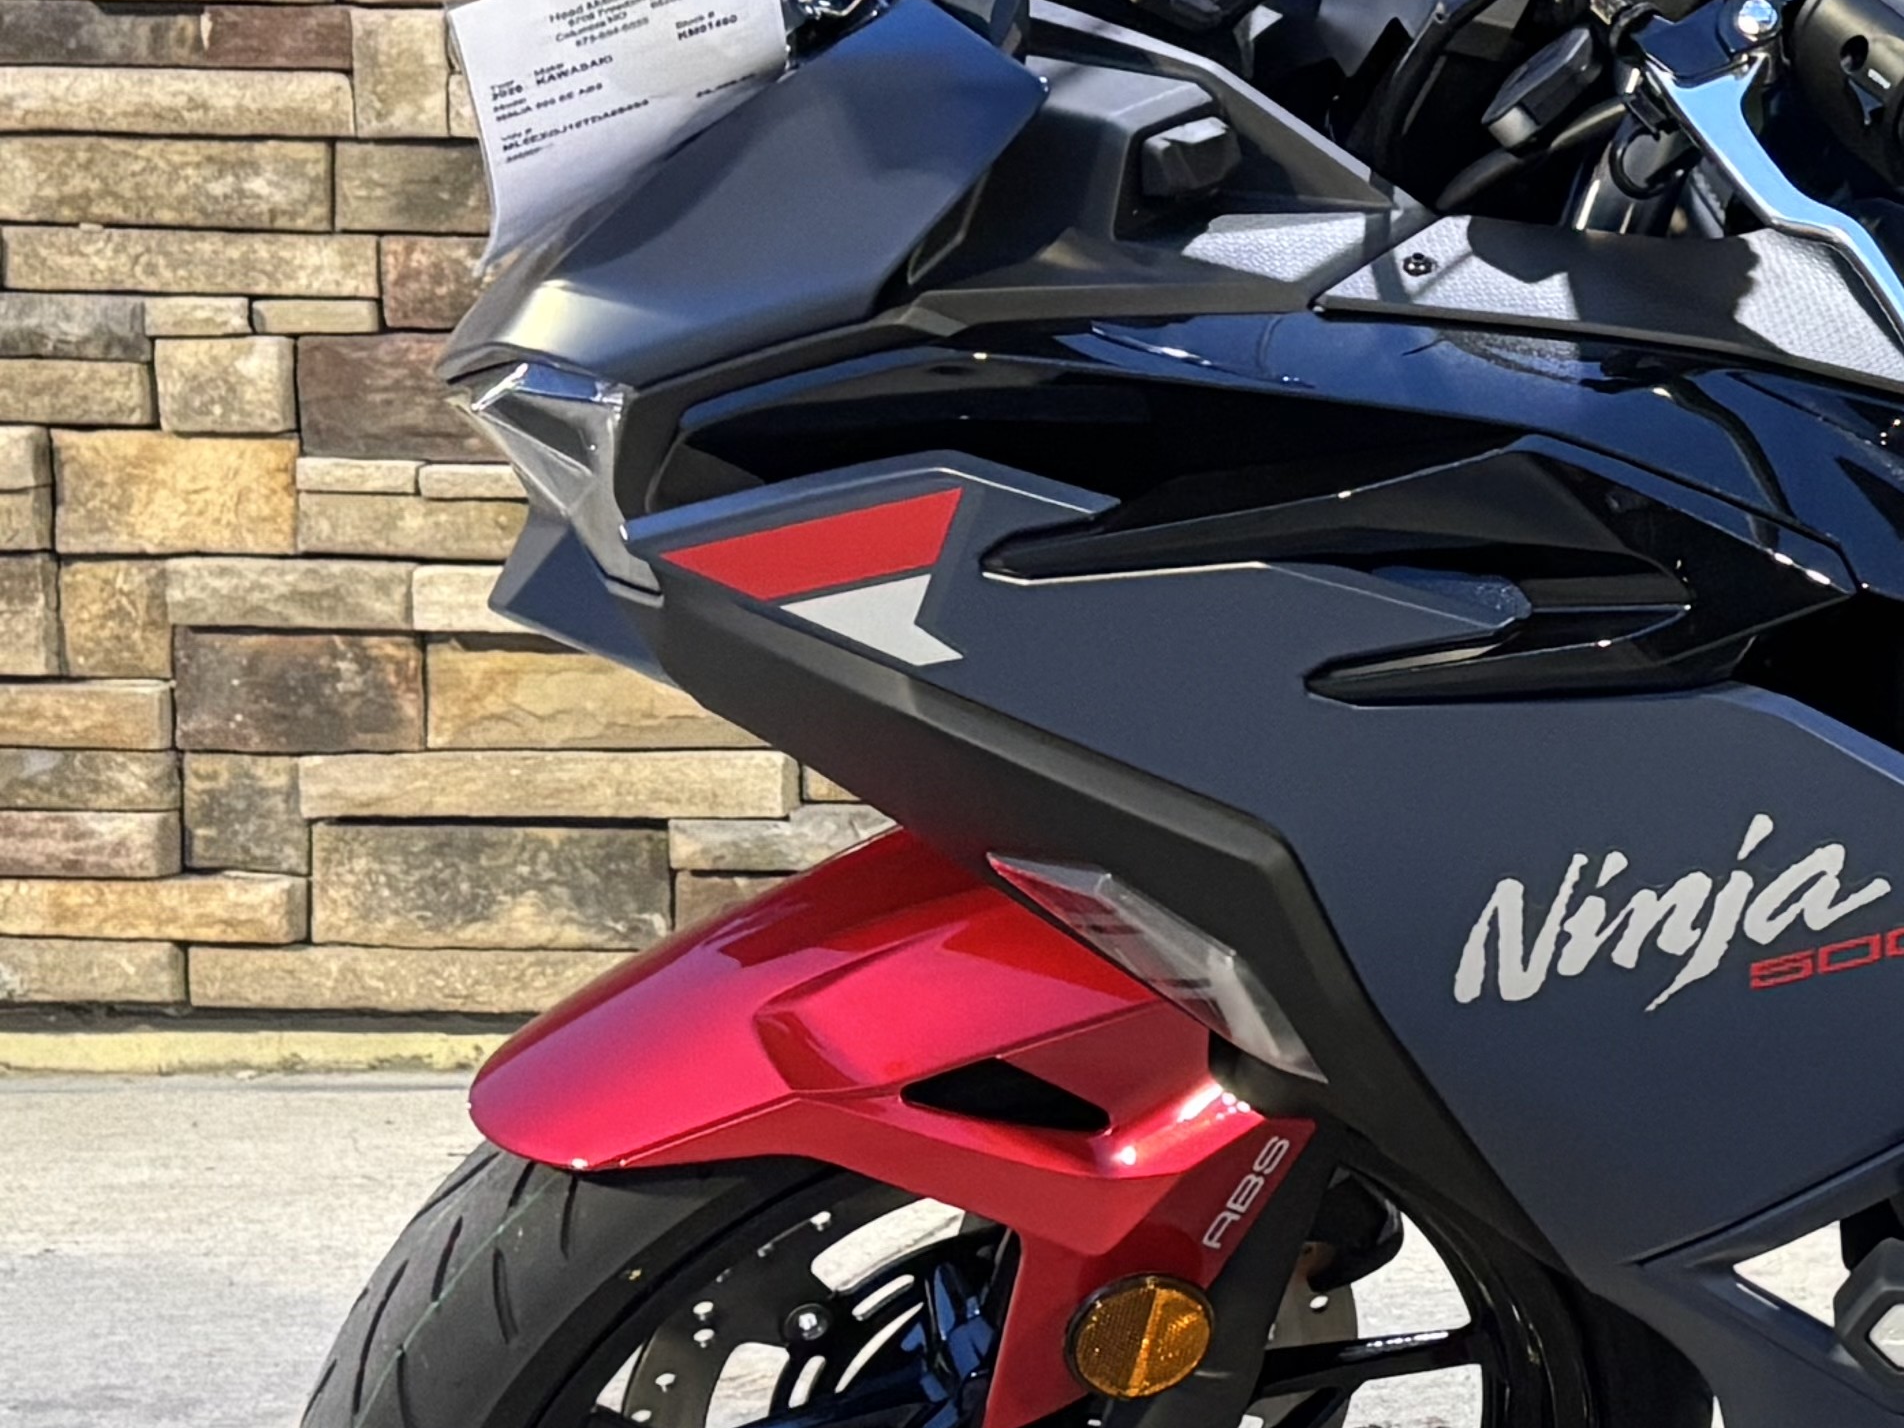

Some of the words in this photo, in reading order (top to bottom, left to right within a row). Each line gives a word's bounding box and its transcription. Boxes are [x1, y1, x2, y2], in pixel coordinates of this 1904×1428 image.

[535, 54, 614, 86] KAWASAKI
[1453, 812, 1892, 1012] Ninja
[1202, 1134, 1291, 1250] ABS
